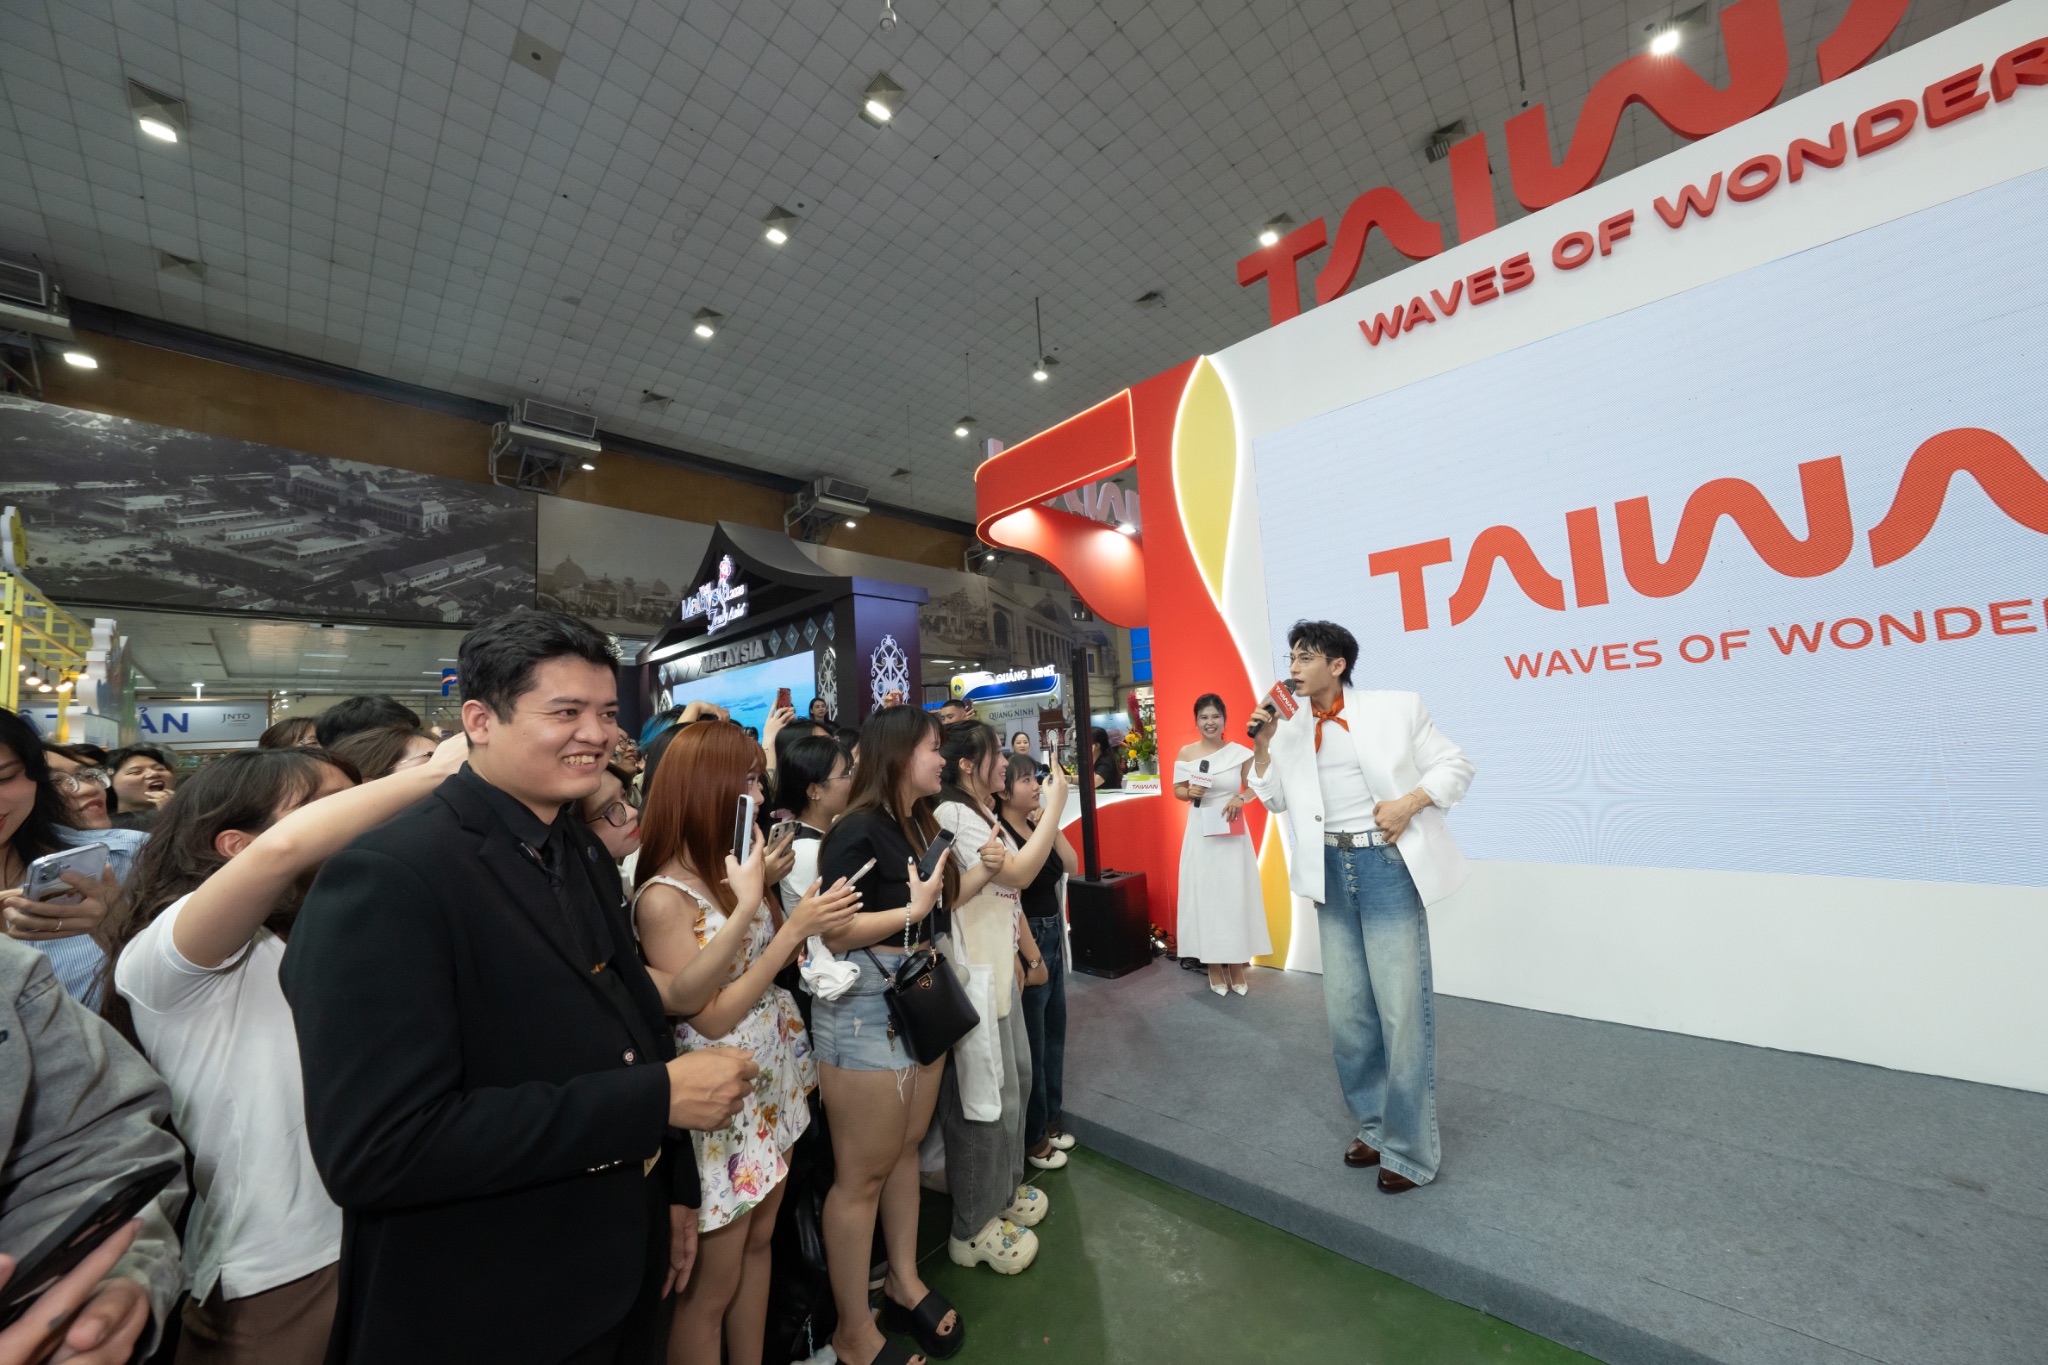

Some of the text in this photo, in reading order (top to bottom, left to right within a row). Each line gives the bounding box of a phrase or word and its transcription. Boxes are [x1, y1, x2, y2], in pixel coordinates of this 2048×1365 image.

[1359, 37, 2048, 347] WAVES OF WONDER
[1504, 597, 2048, 680] WAVES OF WONDE
[701, 639, 766, 673] MALAYSIA
[995, 664, 1056, 684] QUẢNG NINH
[1275, 684, 1296, 714] TAIWAN
[139, 706, 189, 734] ẢN
[222, 713, 251, 724] JNTO
[988, 707, 1034, 722] QUẢNG NINH
[1190, 774, 1213, 783] TAIWAN
